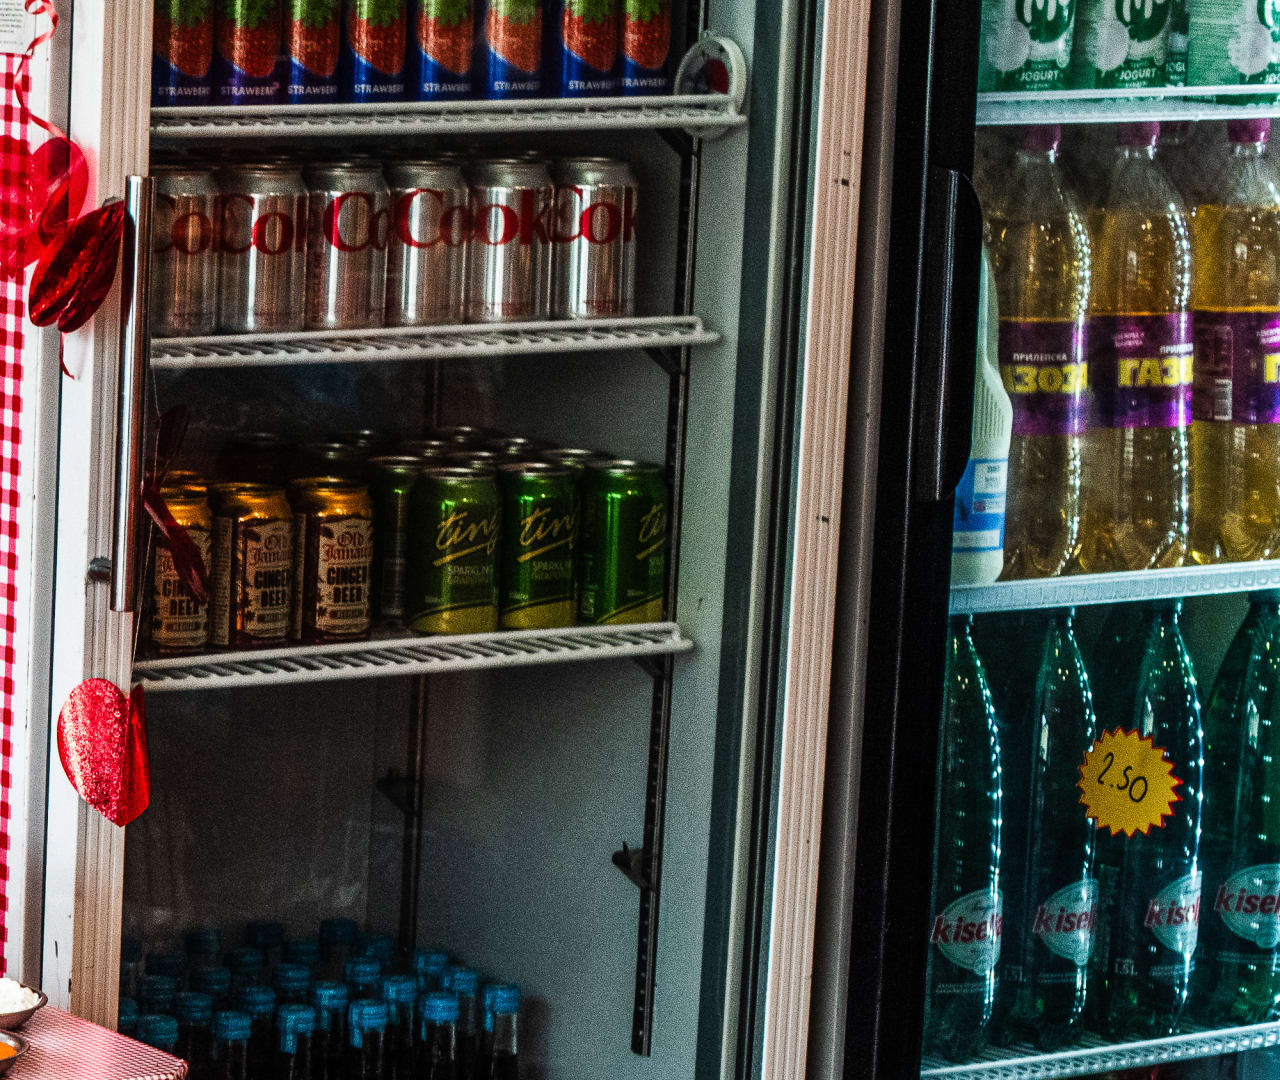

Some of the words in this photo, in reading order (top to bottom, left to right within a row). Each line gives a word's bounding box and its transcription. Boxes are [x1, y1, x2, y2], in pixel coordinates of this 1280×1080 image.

[1020, 70, 1059, 81] JOGURT
[1119, 68, 1157, 80] JOGURT
[1097, 752, 1148, 803] 2.50
